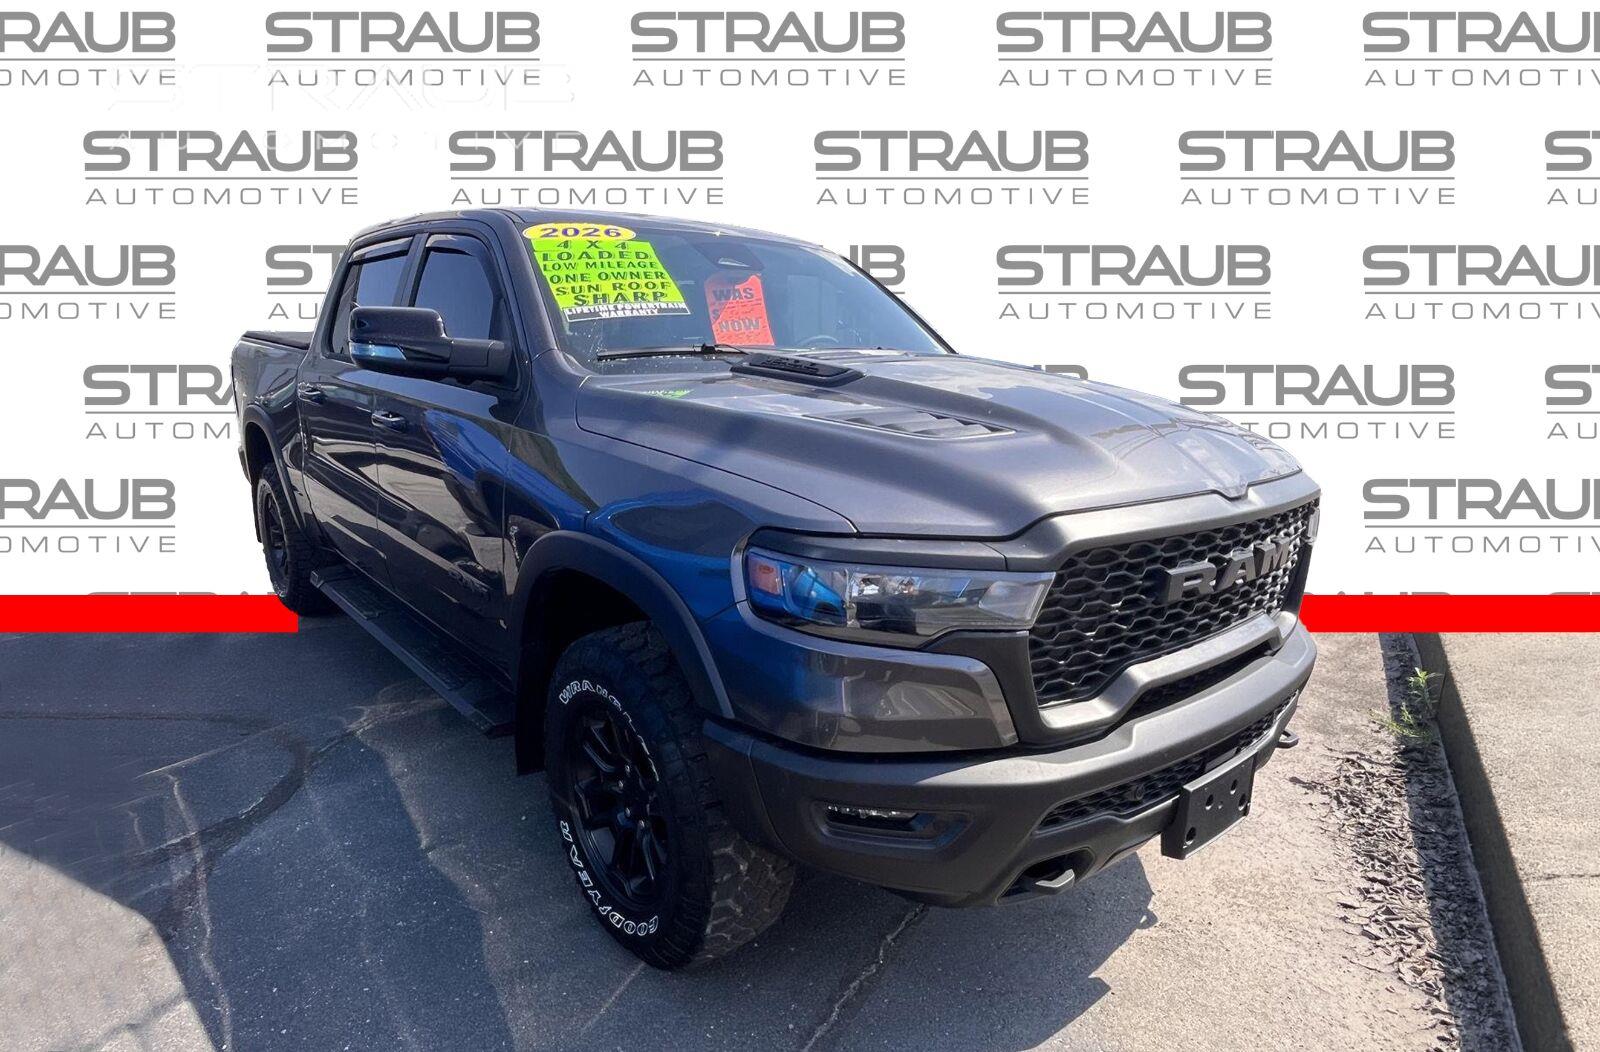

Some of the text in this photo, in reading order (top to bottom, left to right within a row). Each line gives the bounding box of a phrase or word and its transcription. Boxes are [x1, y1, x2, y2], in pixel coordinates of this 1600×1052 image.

[540, 227, 622, 238] 2026
[542, 251, 652, 262] LOADED
[543, 260, 658, 272] LOW MILEAGE
[549, 271, 667, 285] ONE OWNER
[556, 281, 671, 296] SUN ROOF
[712, 287, 754, 301] WAS
[574, 292, 669, 306] SHARP
[565, 302, 688, 315] LIFETIME POWERTRAIN
[599, 308, 658, 318] WARRANTY
[719, 319, 760, 332] NOW
[1167, 536, 1290, 601] RAM
